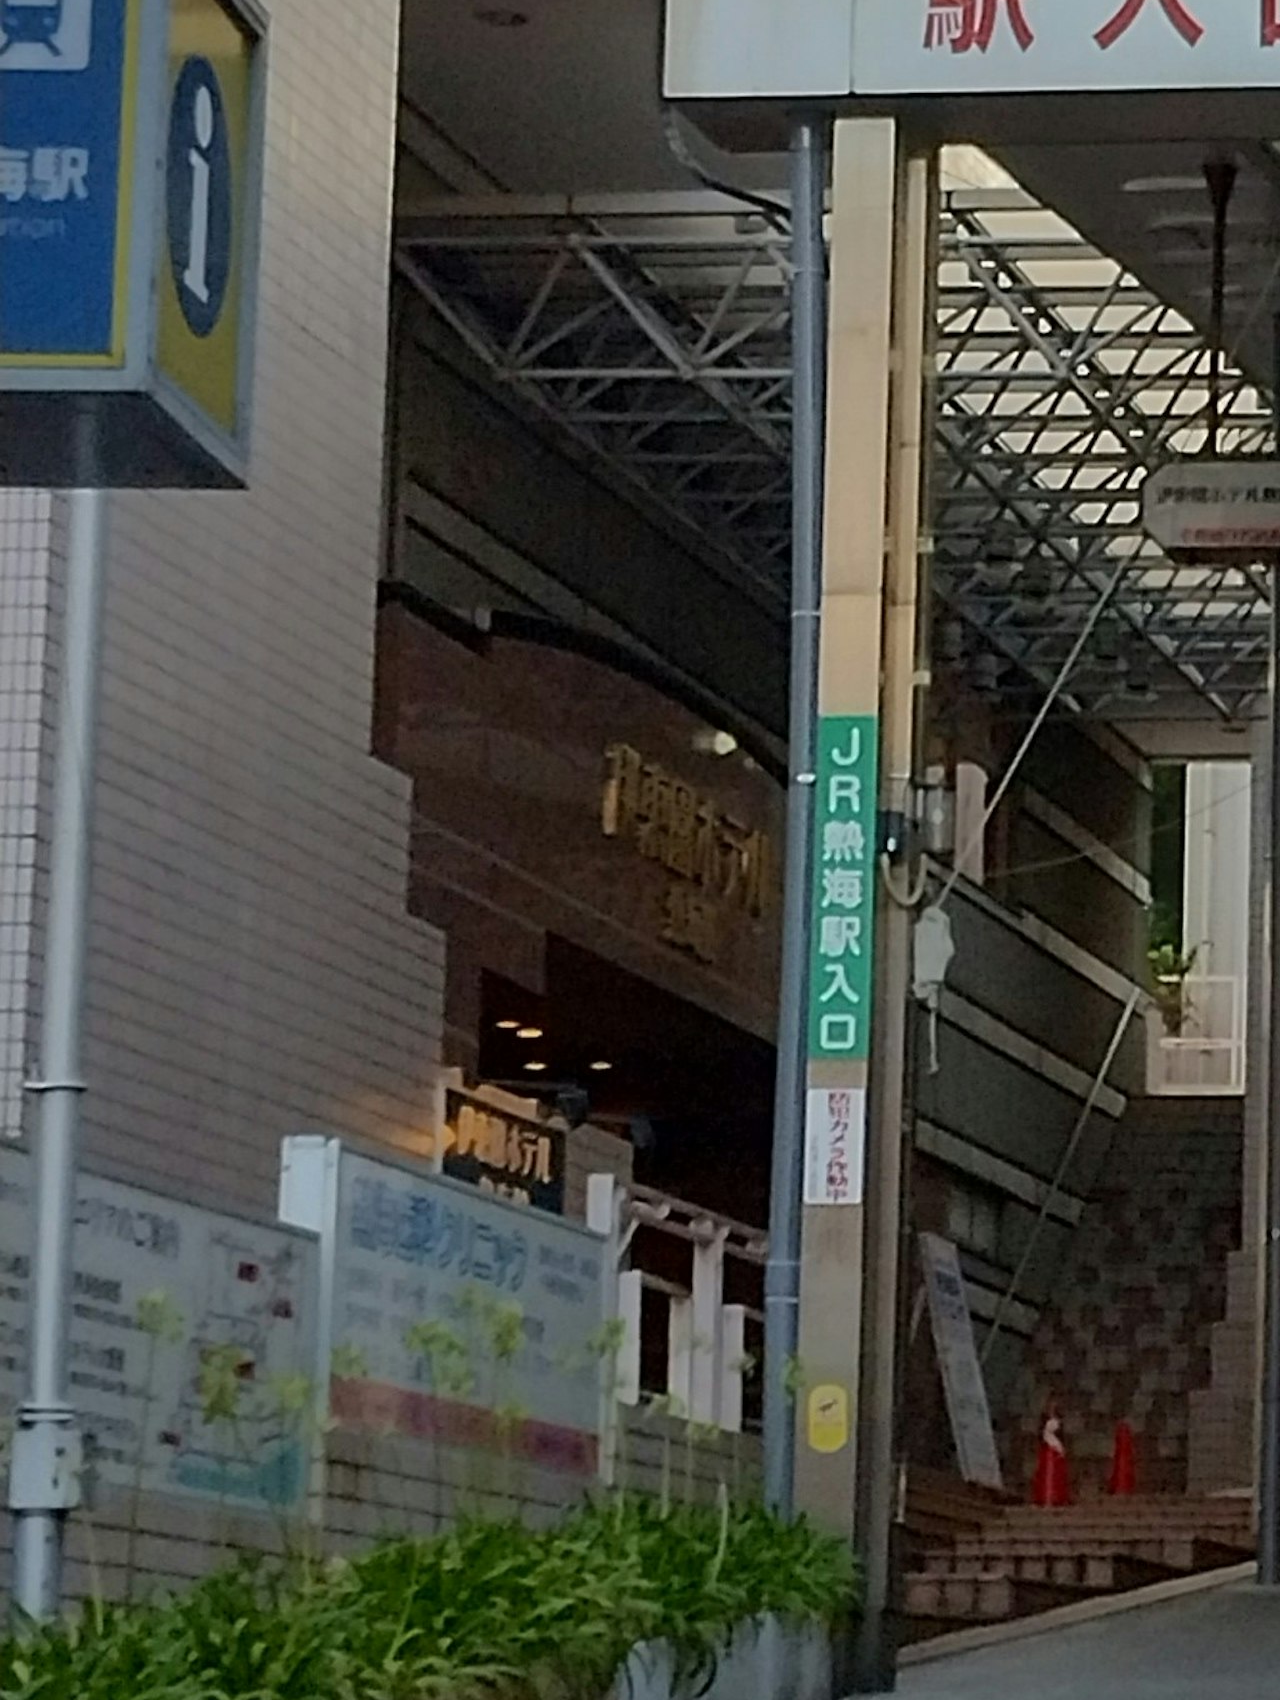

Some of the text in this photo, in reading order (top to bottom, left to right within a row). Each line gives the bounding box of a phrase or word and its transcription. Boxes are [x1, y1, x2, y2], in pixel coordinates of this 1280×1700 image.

[817, 726, 866, 1054] JR熱海駅入口
